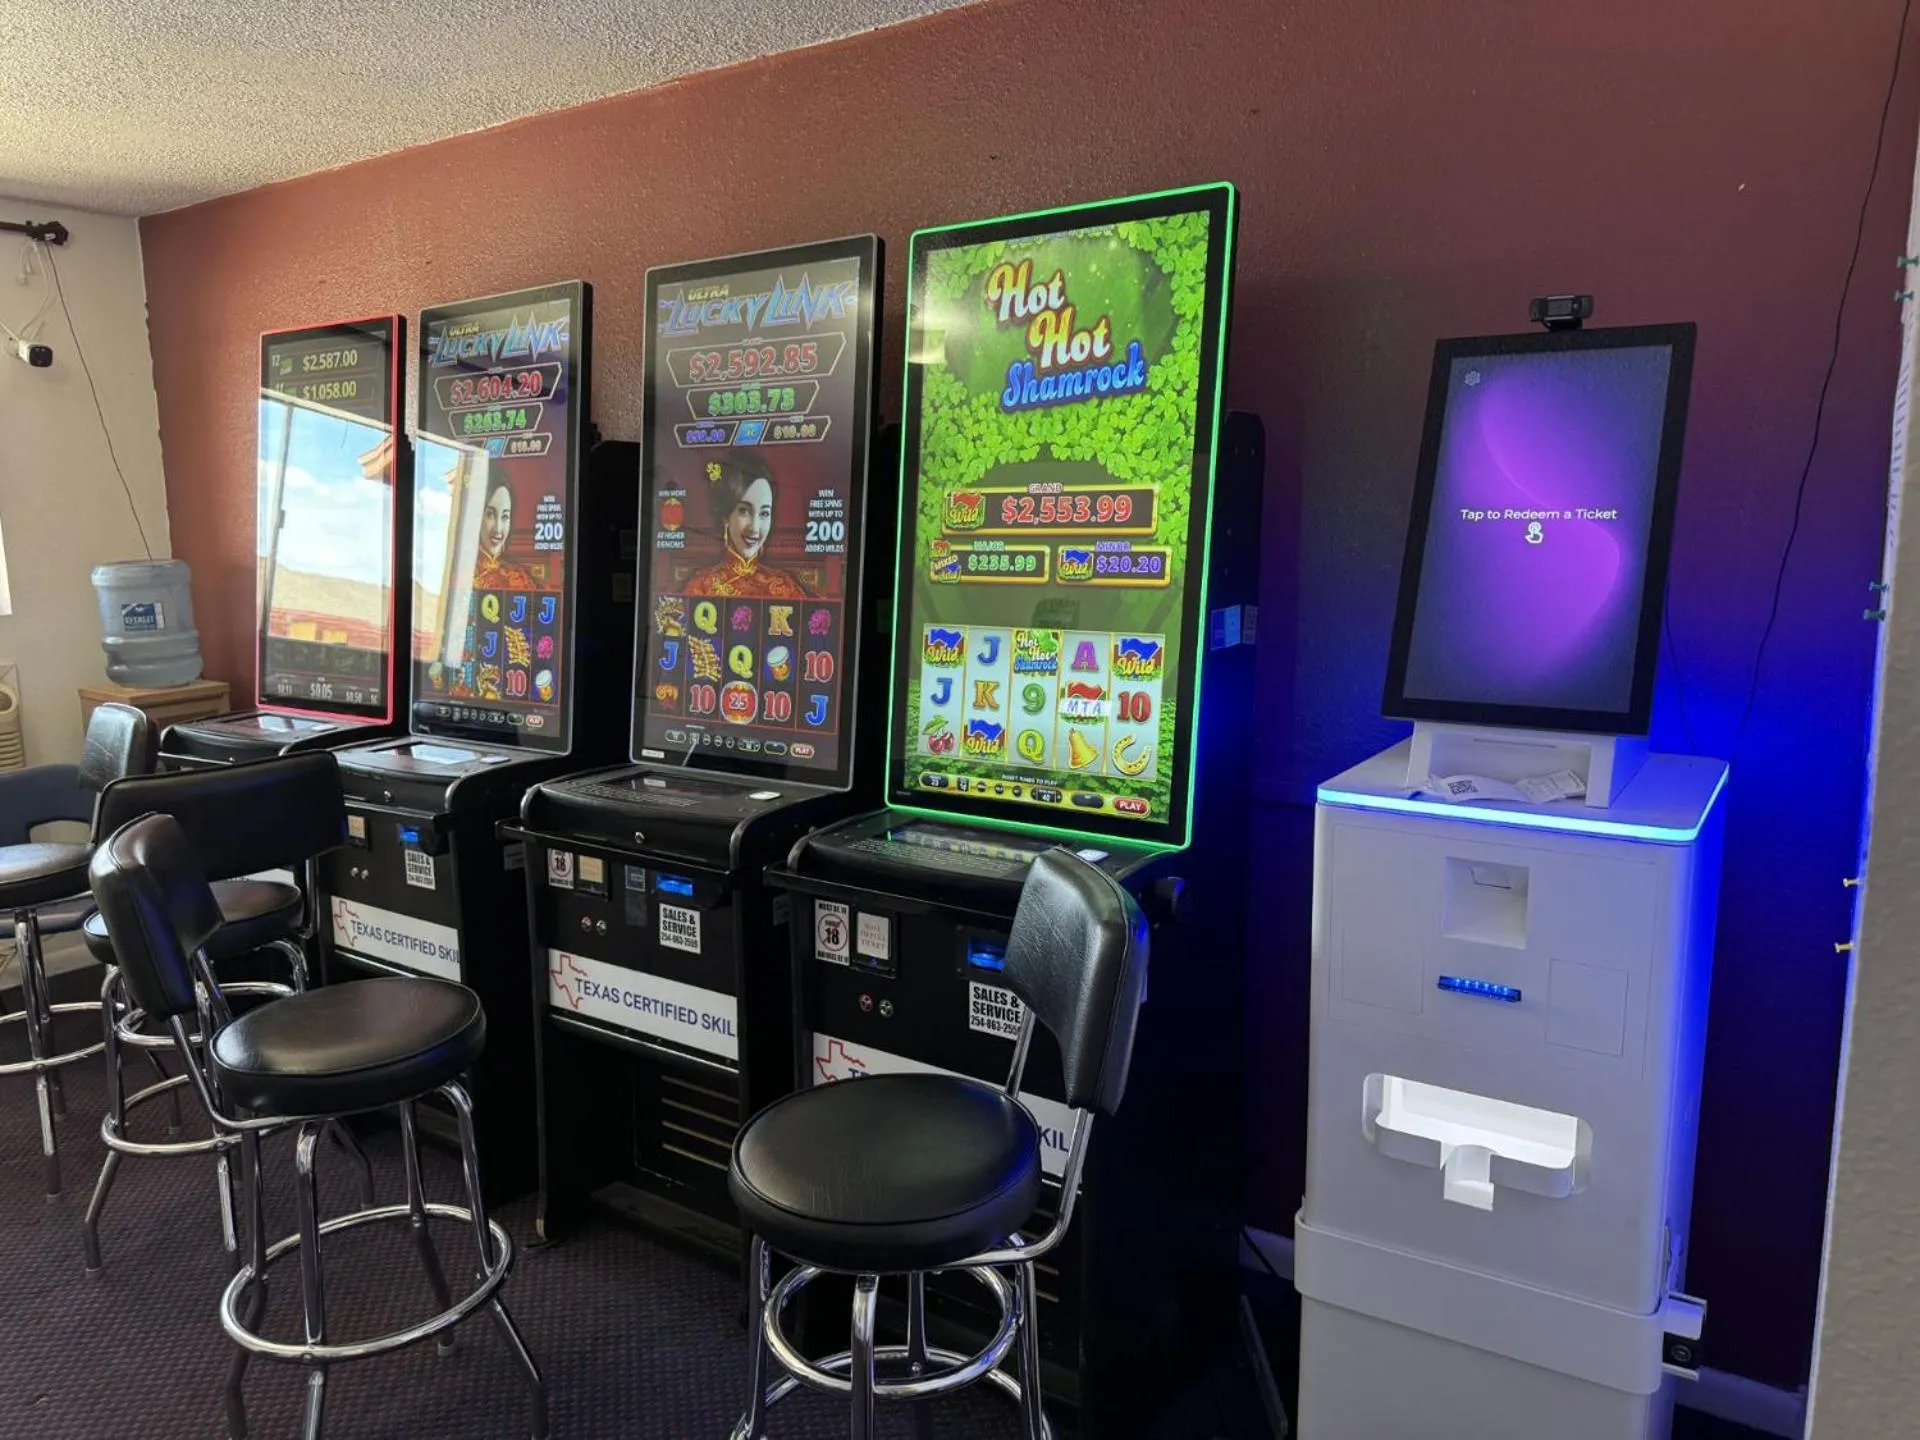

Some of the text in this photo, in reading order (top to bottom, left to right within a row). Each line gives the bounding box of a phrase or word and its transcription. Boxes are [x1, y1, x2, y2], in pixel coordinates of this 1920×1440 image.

[985, 258, 1067, 322] Hot
[1027, 307, 1112, 370] Hot
[689, 342, 818, 382] $2,592.85
[1001, 341, 1146, 410] Shamrock
[450, 370, 543, 407] $2,604.20
[1001, 495, 1133, 525] $2,553.99
[1460, 508, 1617, 521] Tap to Redeem a Ticket
[534, 522, 563, 541] 200
[805, 521, 845, 542] 200
[1095, 555, 1163, 574] $20.20
[481, 594, 500, 624] Q
[510, 595, 527, 622] J
[538, 597, 556, 624] J
[693, 600, 718, 634] Q
[767, 604, 793, 637] K
[482, 631, 498, 657] J
[659, 641, 680, 671] J
[977, 636, 1000, 665] J
[1070, 640, 1100, 672] A
[728, 645, 754, 679] Q
[804, 651, 834, 683] 10
[1116, 656, 1156, 675] Wild
[506, 669, 527, 697] 10
[930, 677, 953, 706] J
[973, 679, 1000, 711] K
[689, 684, 716, 715] 10
[763, 691, 792, 722] 10
[804, 695, 829, 726] J
[1022, 683, 1046, 716] 9
[1117, 690, 1152, 723] 10
[1016, 728, 1046, 764] Q
[1119, 800, 1142, 812] PLAY
[555, 855, 566, 872] 18
[662, 907, 696, 925] SALES &
[662, 919, 697, 938] SERVICE
[350, 919, 382, 941] TEXAS
[384, 930, 436, 956] CERTIFIED
[825, 927, 840, 945] 18
[575, 977, 736, 1037] TEXAS CERTIFIED SKIL
[972, 1000, 1021, 1024] SERVICE
[973, 986, 1019, 1009] SALES &
[1039, 1125, 1069, 1153] KIL
